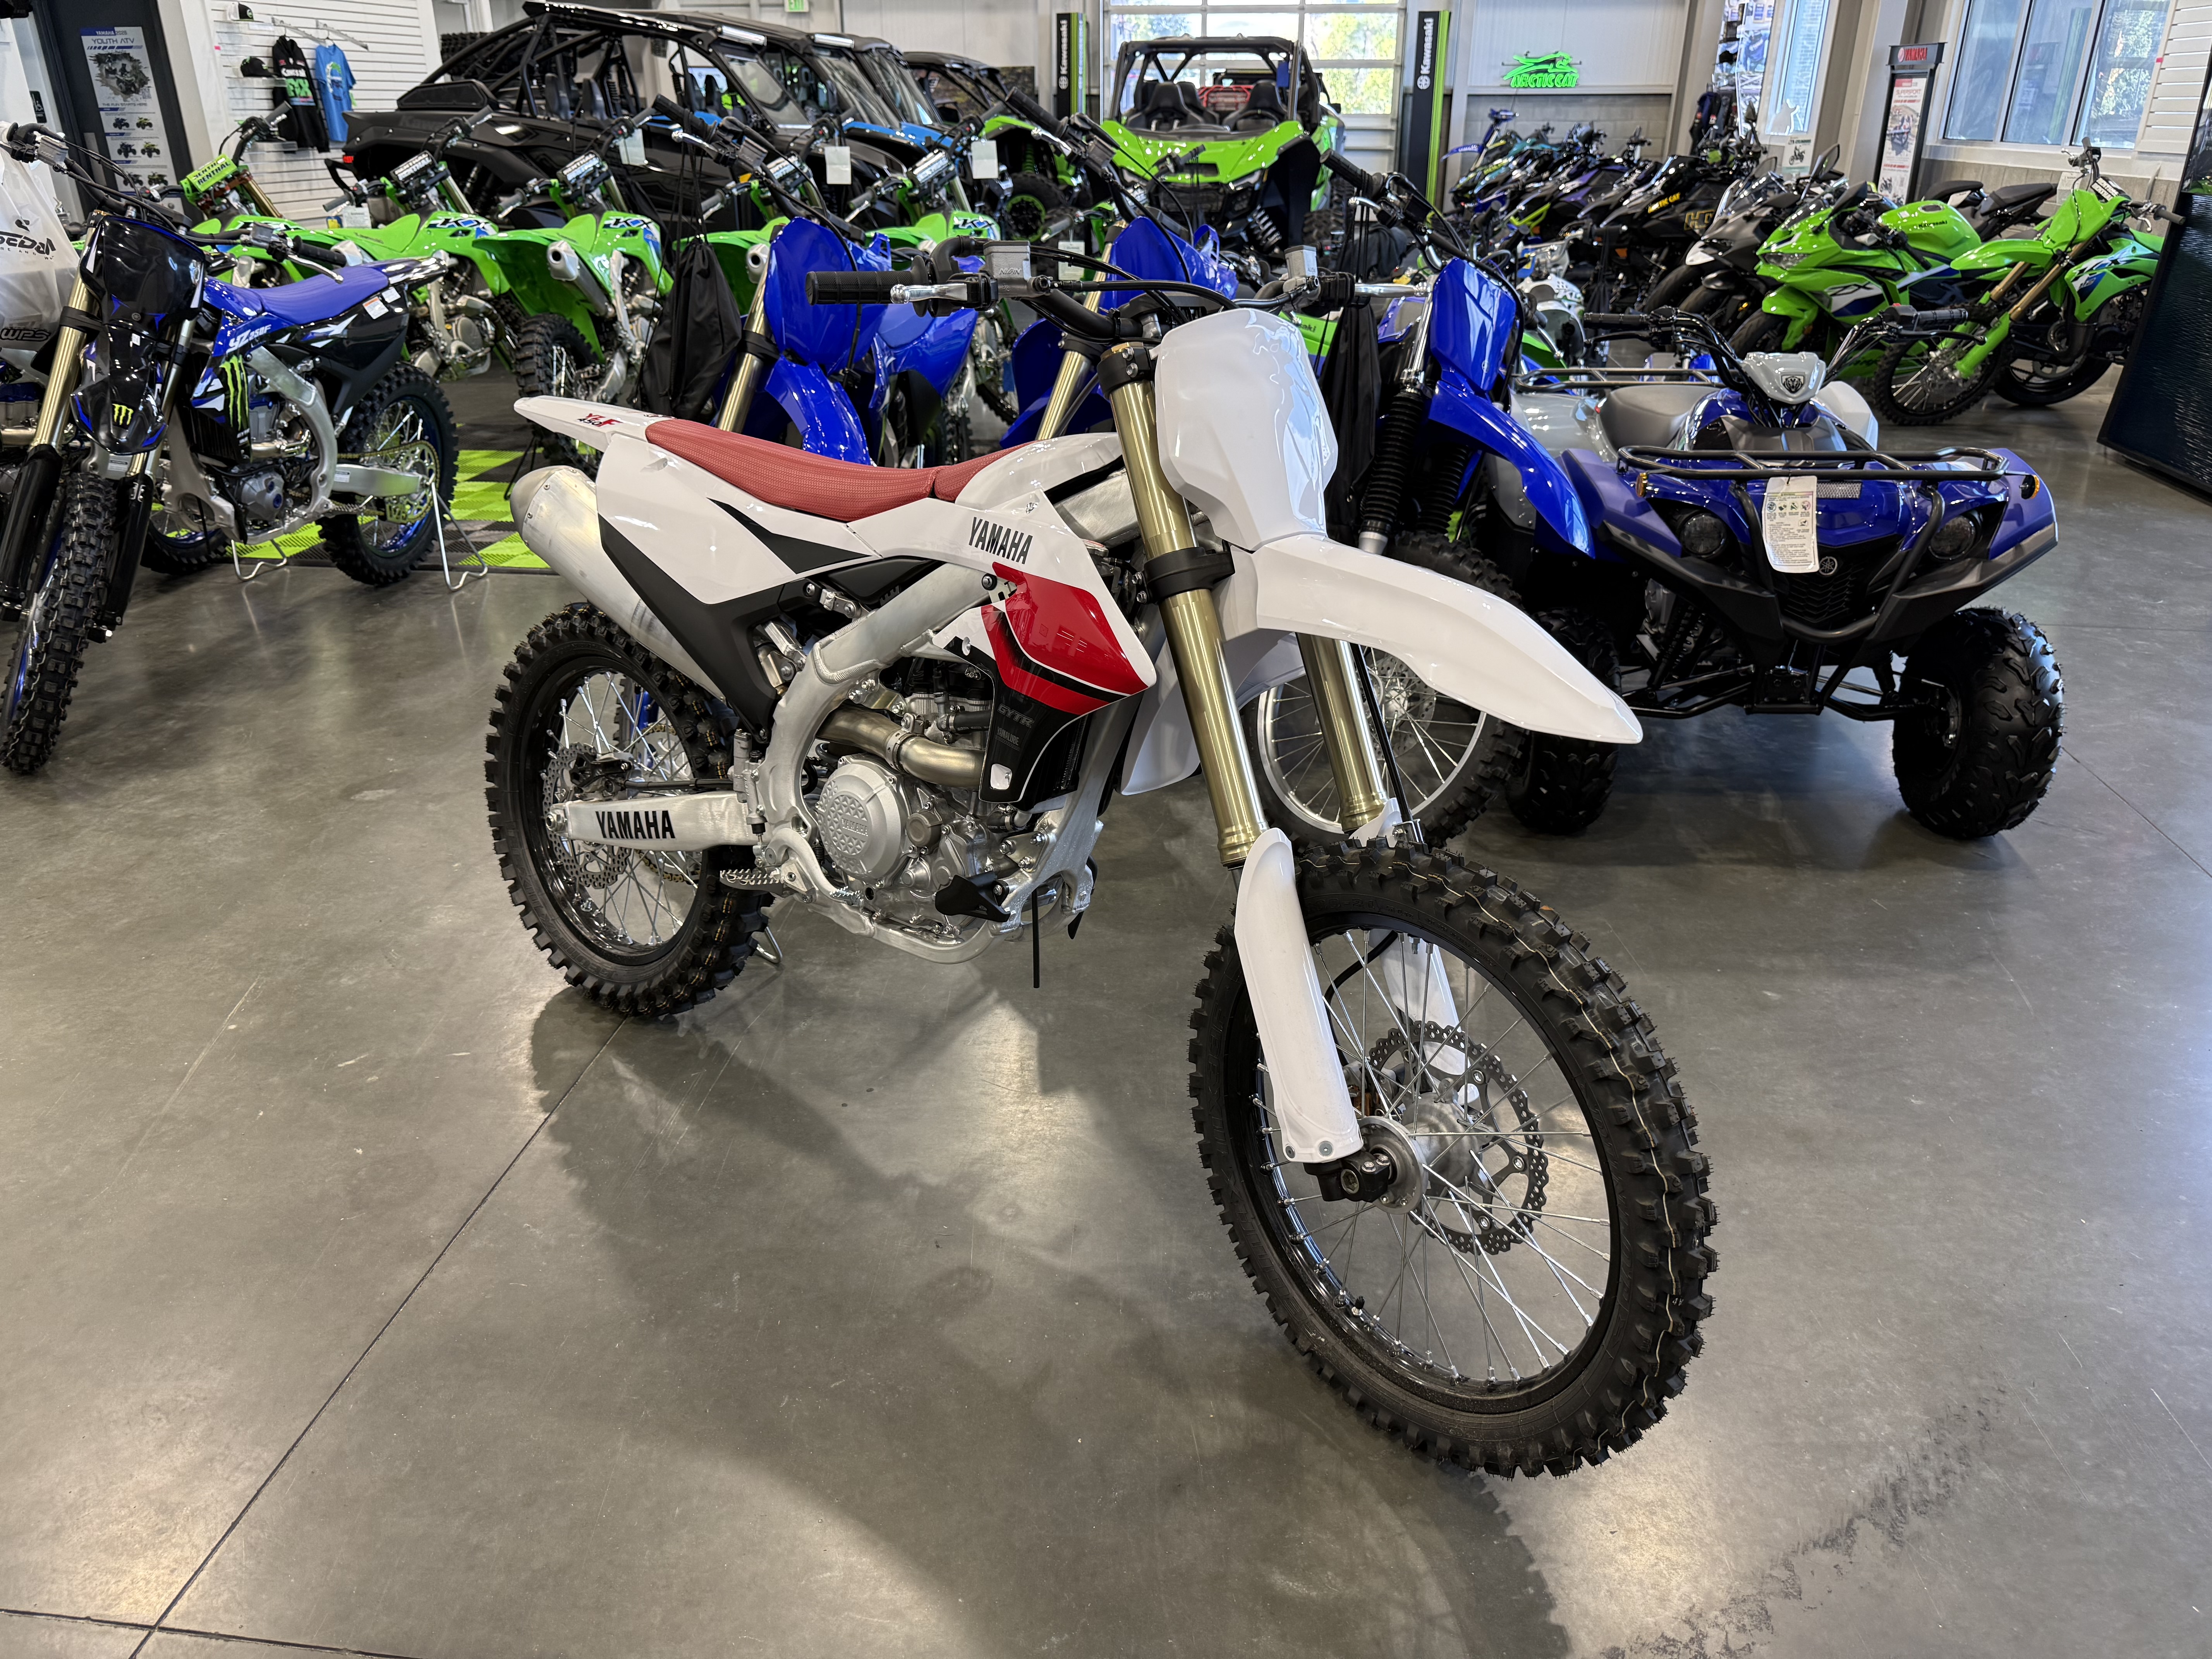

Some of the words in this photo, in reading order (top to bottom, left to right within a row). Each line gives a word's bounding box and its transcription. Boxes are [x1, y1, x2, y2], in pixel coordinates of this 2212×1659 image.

[1420, 18, 1434, 74] Kawasaki
[1554, 73, 1579, 88] CAT
[198, 162, 231, 185] RENTHAL
[0, 328, 51, 342] WPS
[969, 517, 1033, 565] YAMAHA
[997, 703, 1035, 728] GYTR
[997, 726, 1019, 746] YAMALUBE
[595, 810, 676, 839] YAMAHA
